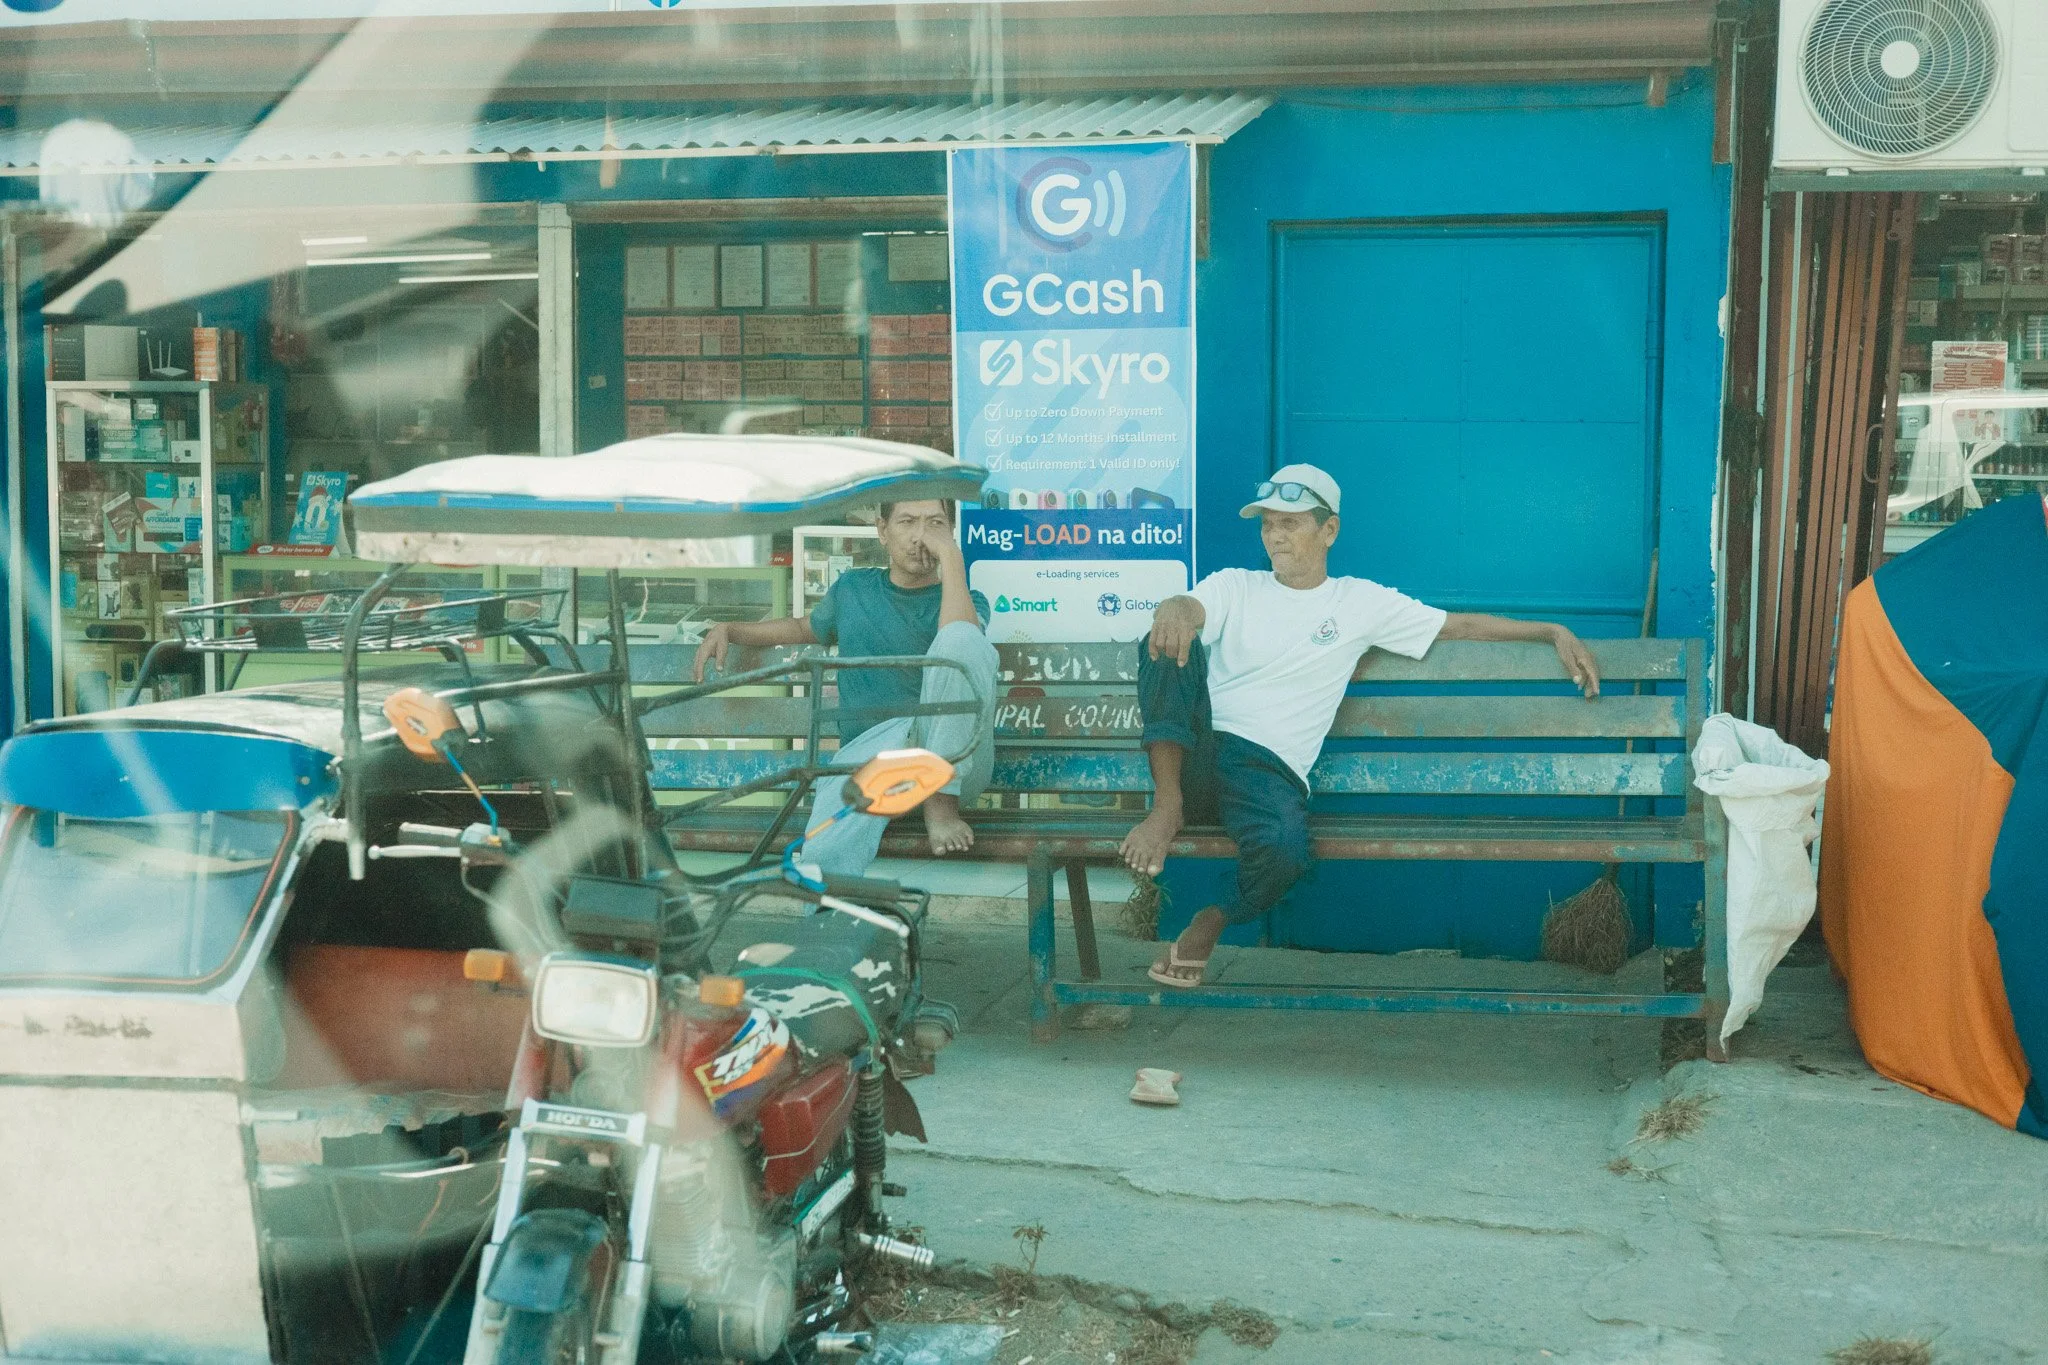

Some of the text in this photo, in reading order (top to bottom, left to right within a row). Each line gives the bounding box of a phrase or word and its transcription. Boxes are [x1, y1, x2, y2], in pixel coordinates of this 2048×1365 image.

[983, 269, 1164, 317] GCash
[1032, 338, 1170, 400] Skyro
[1006, 406, 1164, 420] Up to Zero Down Payment
[1006, 432, 1177, 446] Up to 12 Months Installment
[1006, 458, 1181, 472] Requirement: 1 Valid ID only!
[316, 474, 341, 488] Skyro
[967, 523, 1183, 550] Mag-LOAD na dito!
[1036, 569, 1120, 580] e-Loading services
[1012, 597, 1058, 612] Smart
